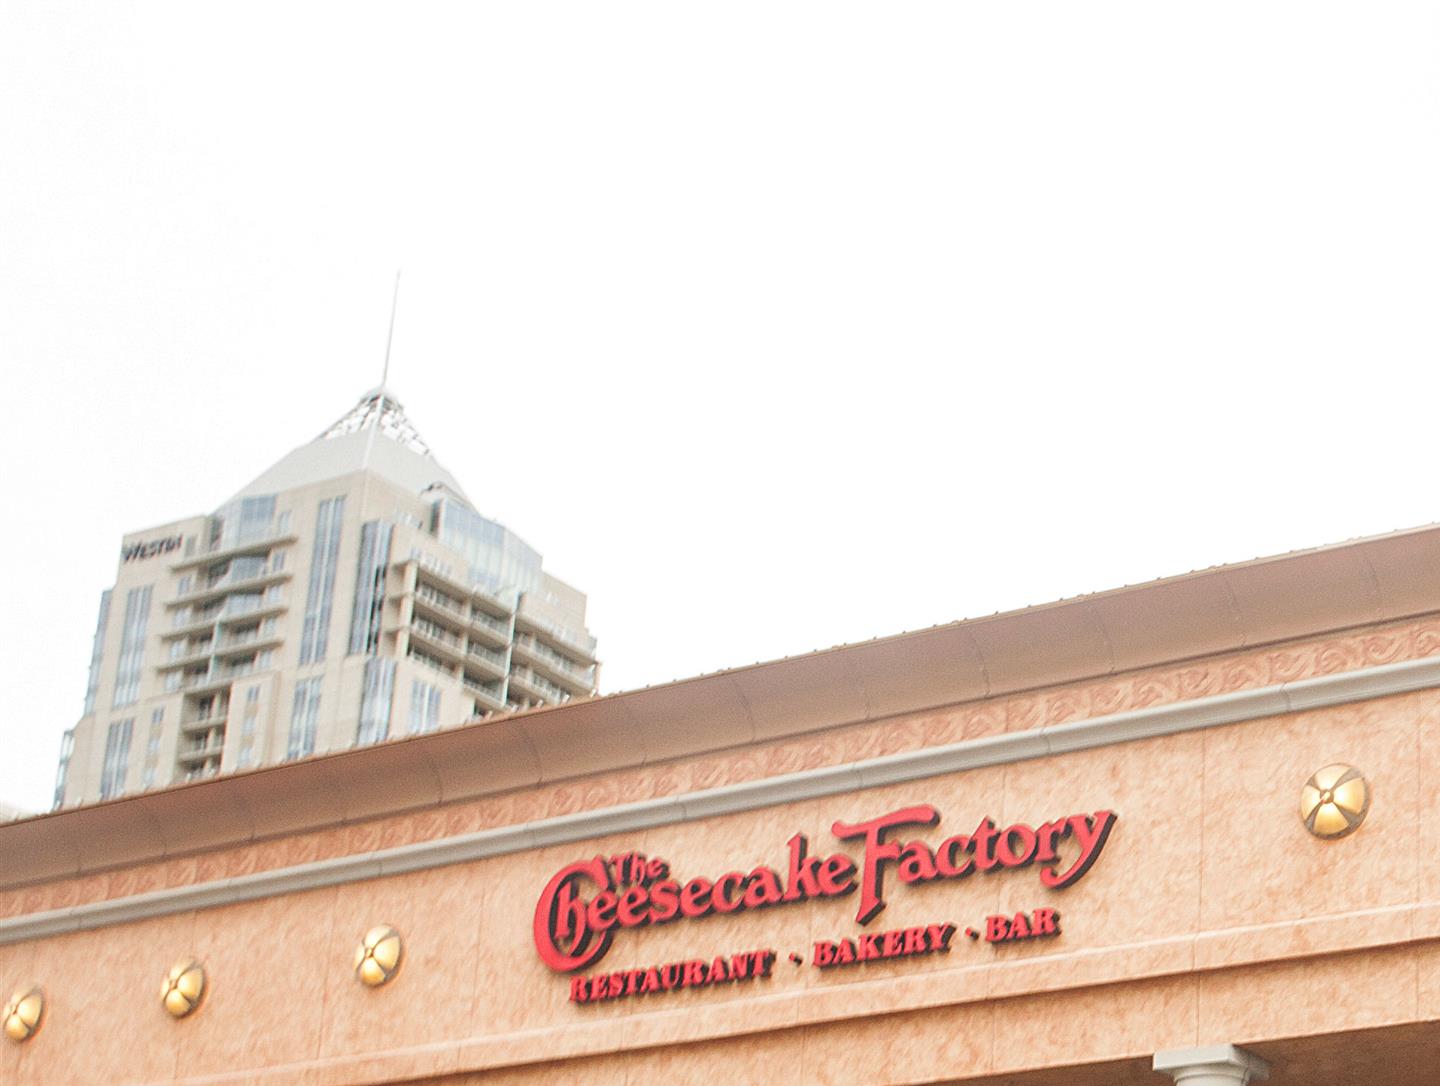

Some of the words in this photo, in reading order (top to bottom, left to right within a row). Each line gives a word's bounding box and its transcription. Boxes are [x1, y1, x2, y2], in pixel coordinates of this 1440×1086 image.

[533, 833, 859, 973] Cheesecake
[831, 804, 1118, 925] Factory
[608, 850, 669, 887] The
[568, 947, 775, 1003] RESTAURANT
[812, 921, 955, 967] BAKERY
[985, 906, 1062, 943] BAR
